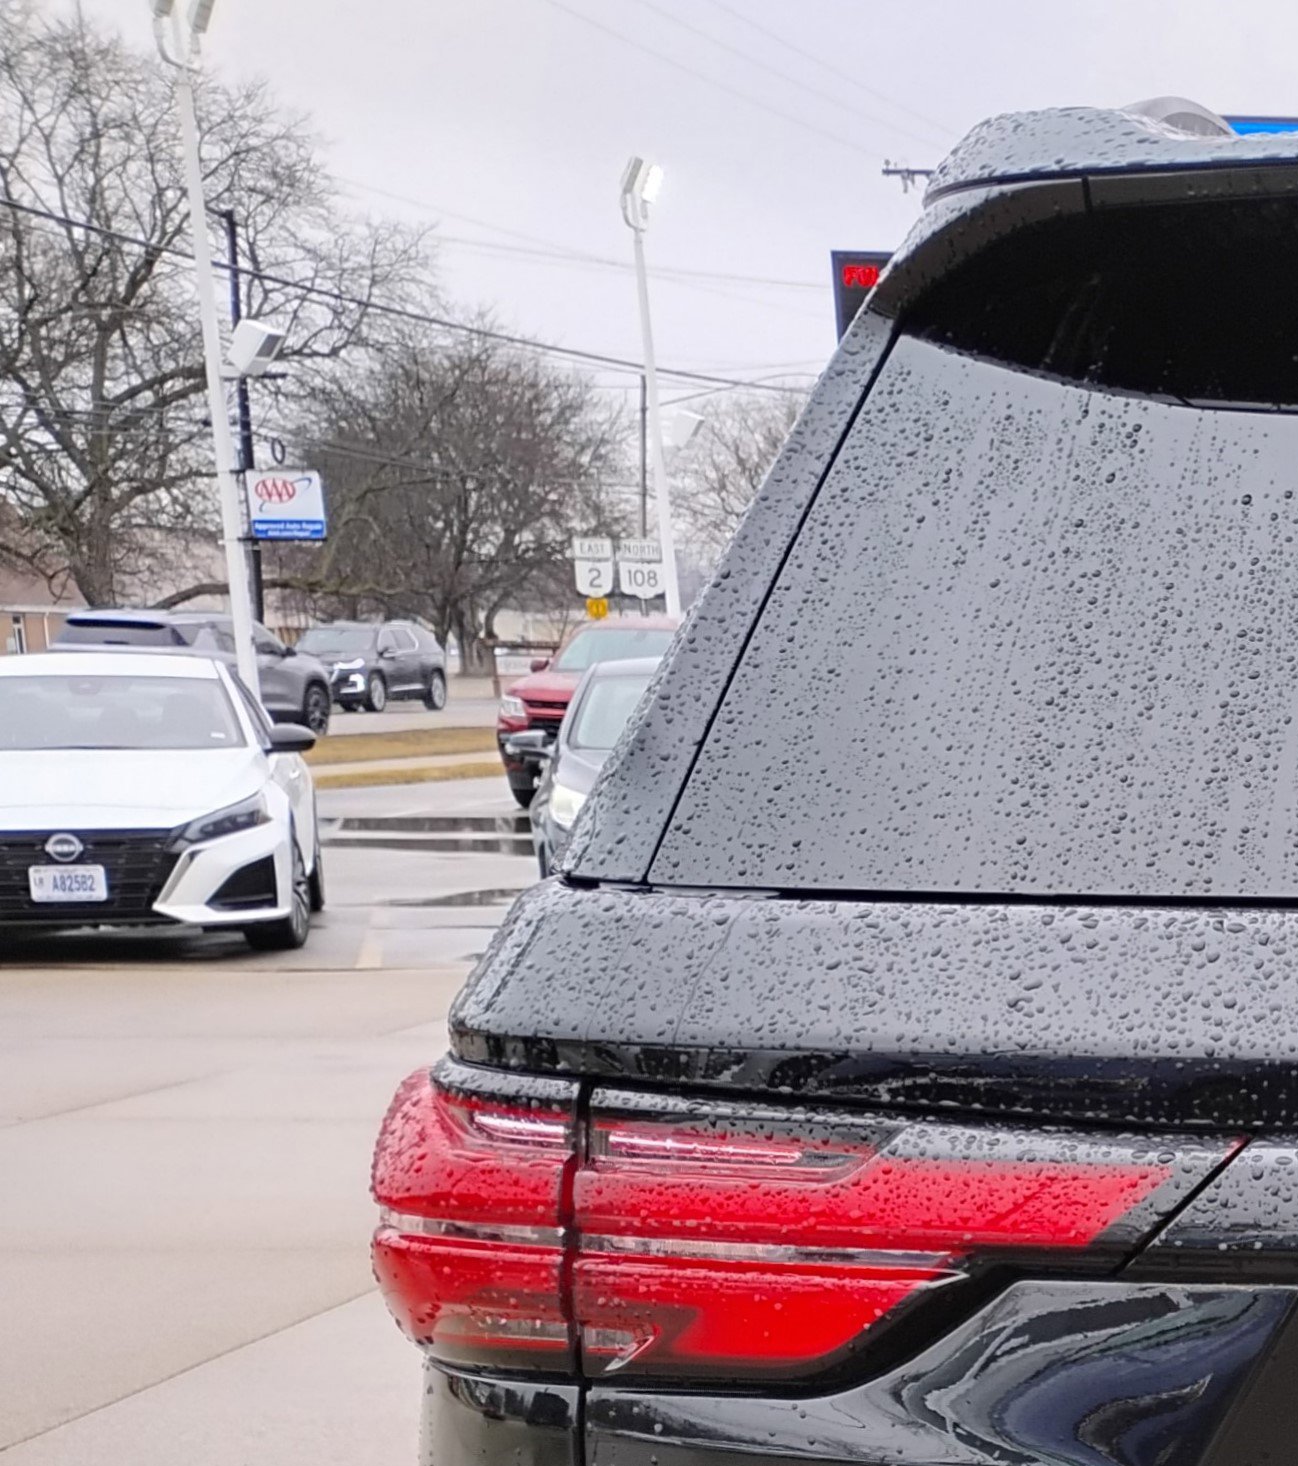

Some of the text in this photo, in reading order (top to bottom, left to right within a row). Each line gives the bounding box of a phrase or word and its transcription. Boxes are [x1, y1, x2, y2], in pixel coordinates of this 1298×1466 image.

[256, 478, 295, 503] AAA
[579, 541, 605, 555] EAST
[623, 543, 660, 557] NORTH
[587, 567, 603, 588] 2
[627, 569, 659, 588] 108
